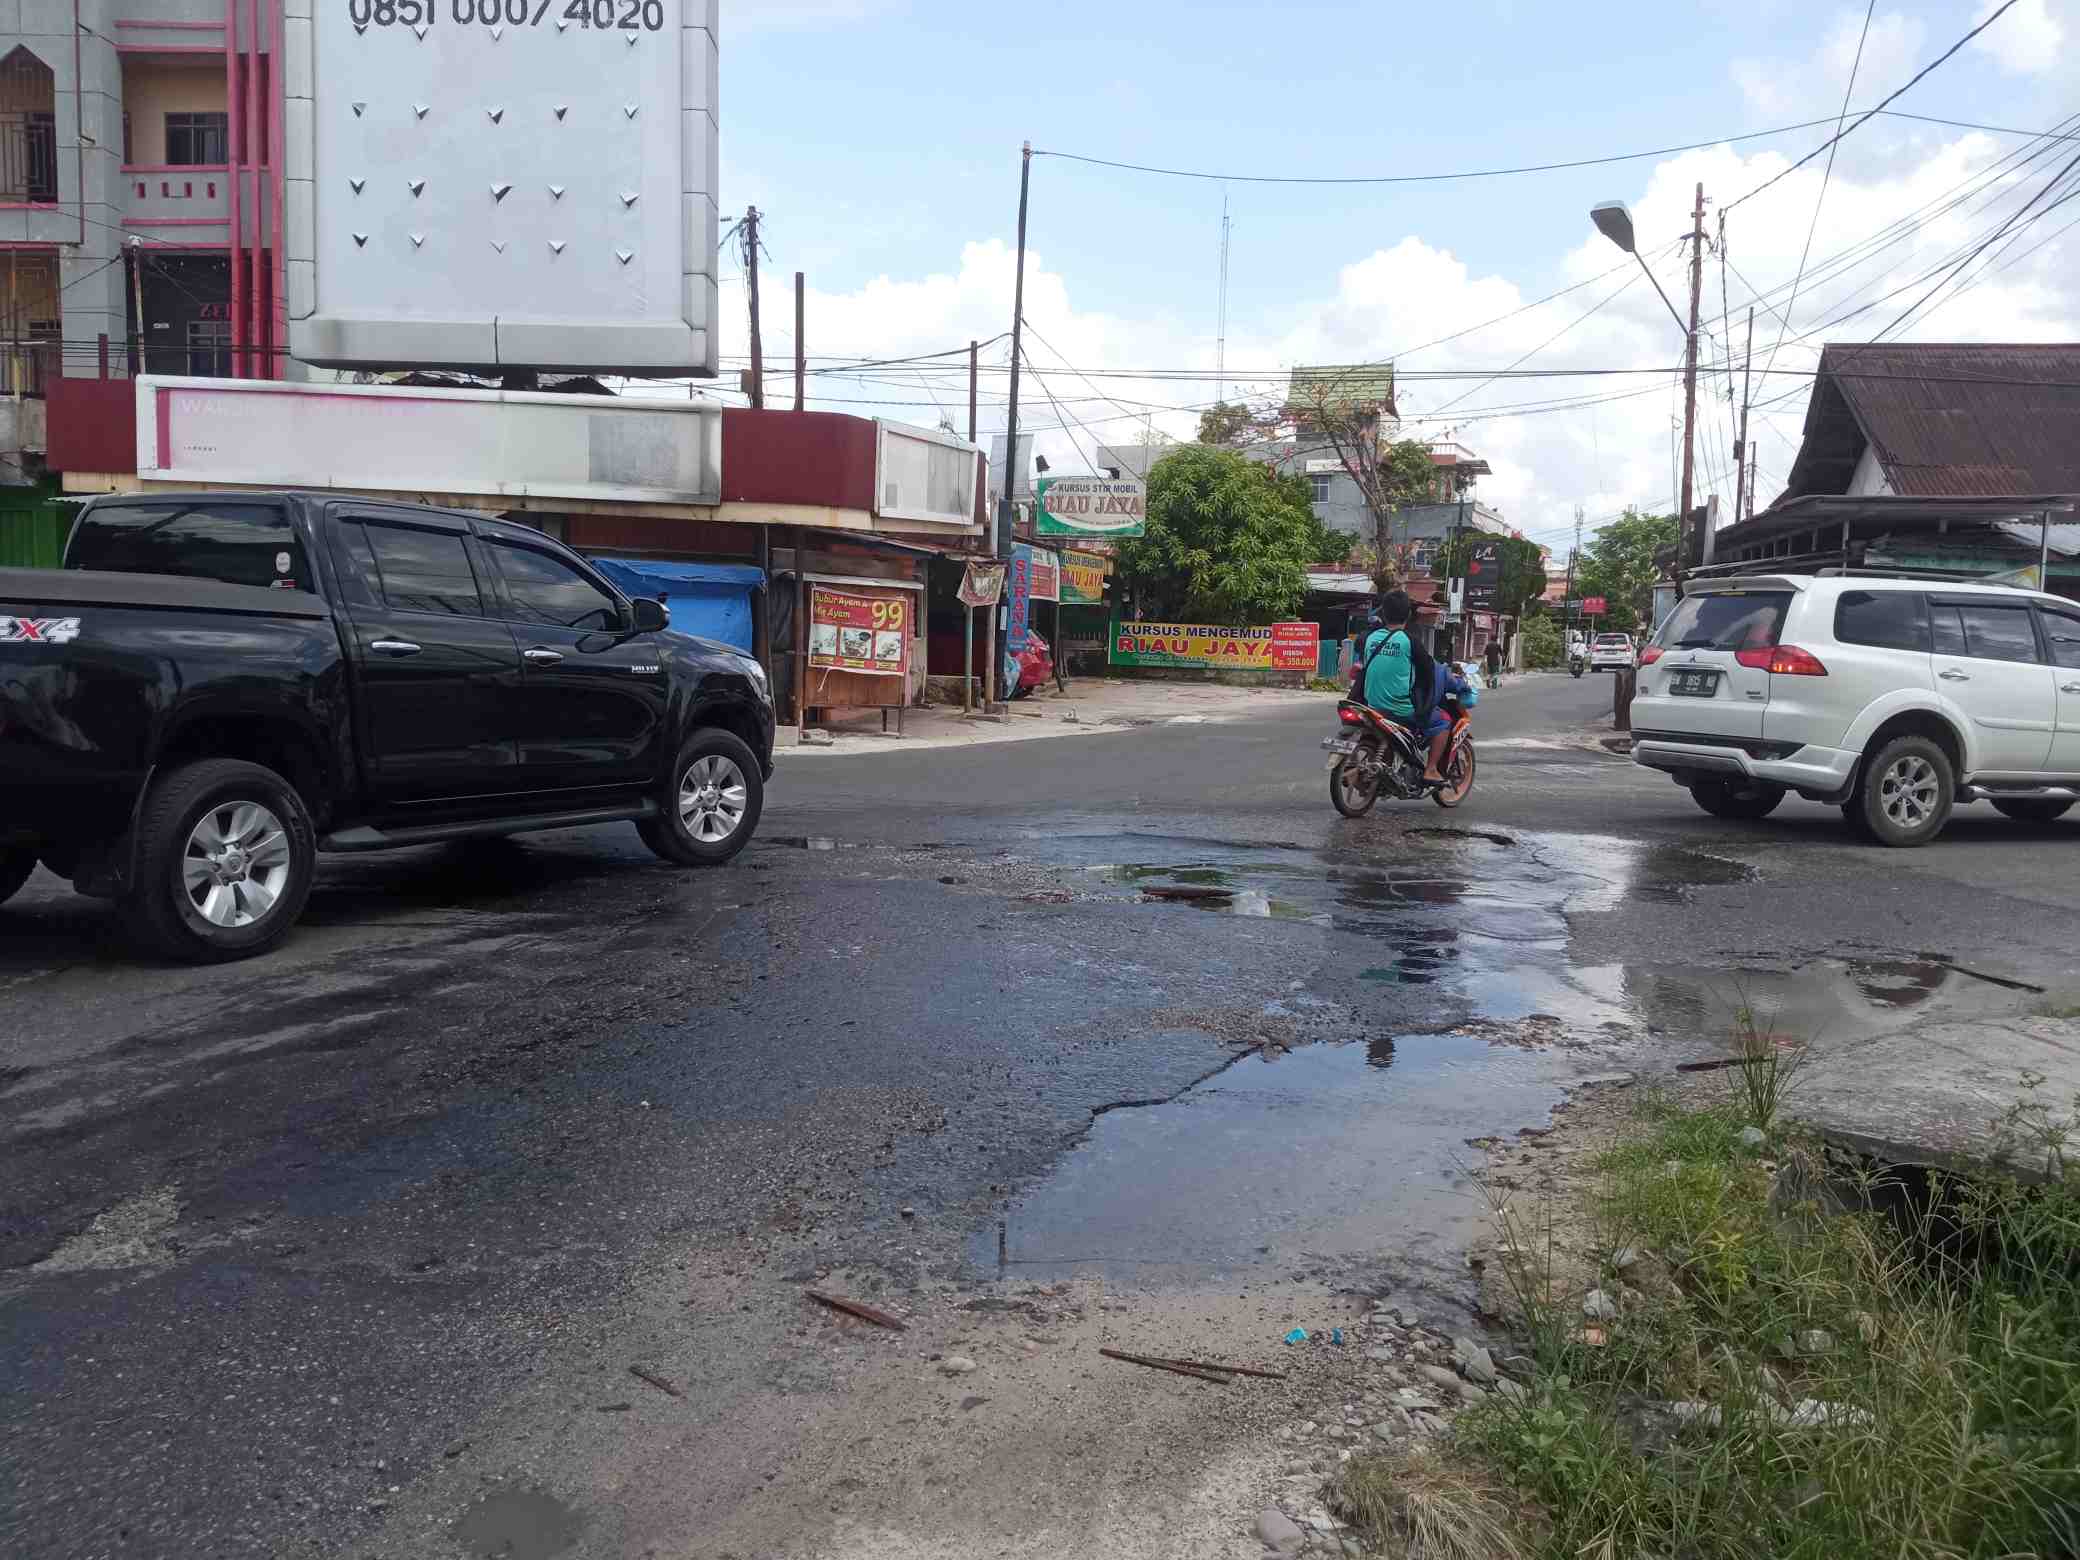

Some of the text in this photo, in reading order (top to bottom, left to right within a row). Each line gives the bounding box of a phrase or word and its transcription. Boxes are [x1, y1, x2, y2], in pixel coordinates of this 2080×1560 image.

[349, 0, 664, 31] 0851 0007 4020
[1058, 484, 1089, 493] KURSUS
[1113, 484, 1138, 493] MOBIL
[1045, 496, 1138, 514] RIAU JAYA
[838, 597, 861, 608] Ayam
[827, 607, 850, 621] Ayam
[871, 600, 904, 630] 99
[1121, 624, 1272, 639] KURSUS MENGEMUD
[1118, 637, 1272, 657] RIAU JAYA
